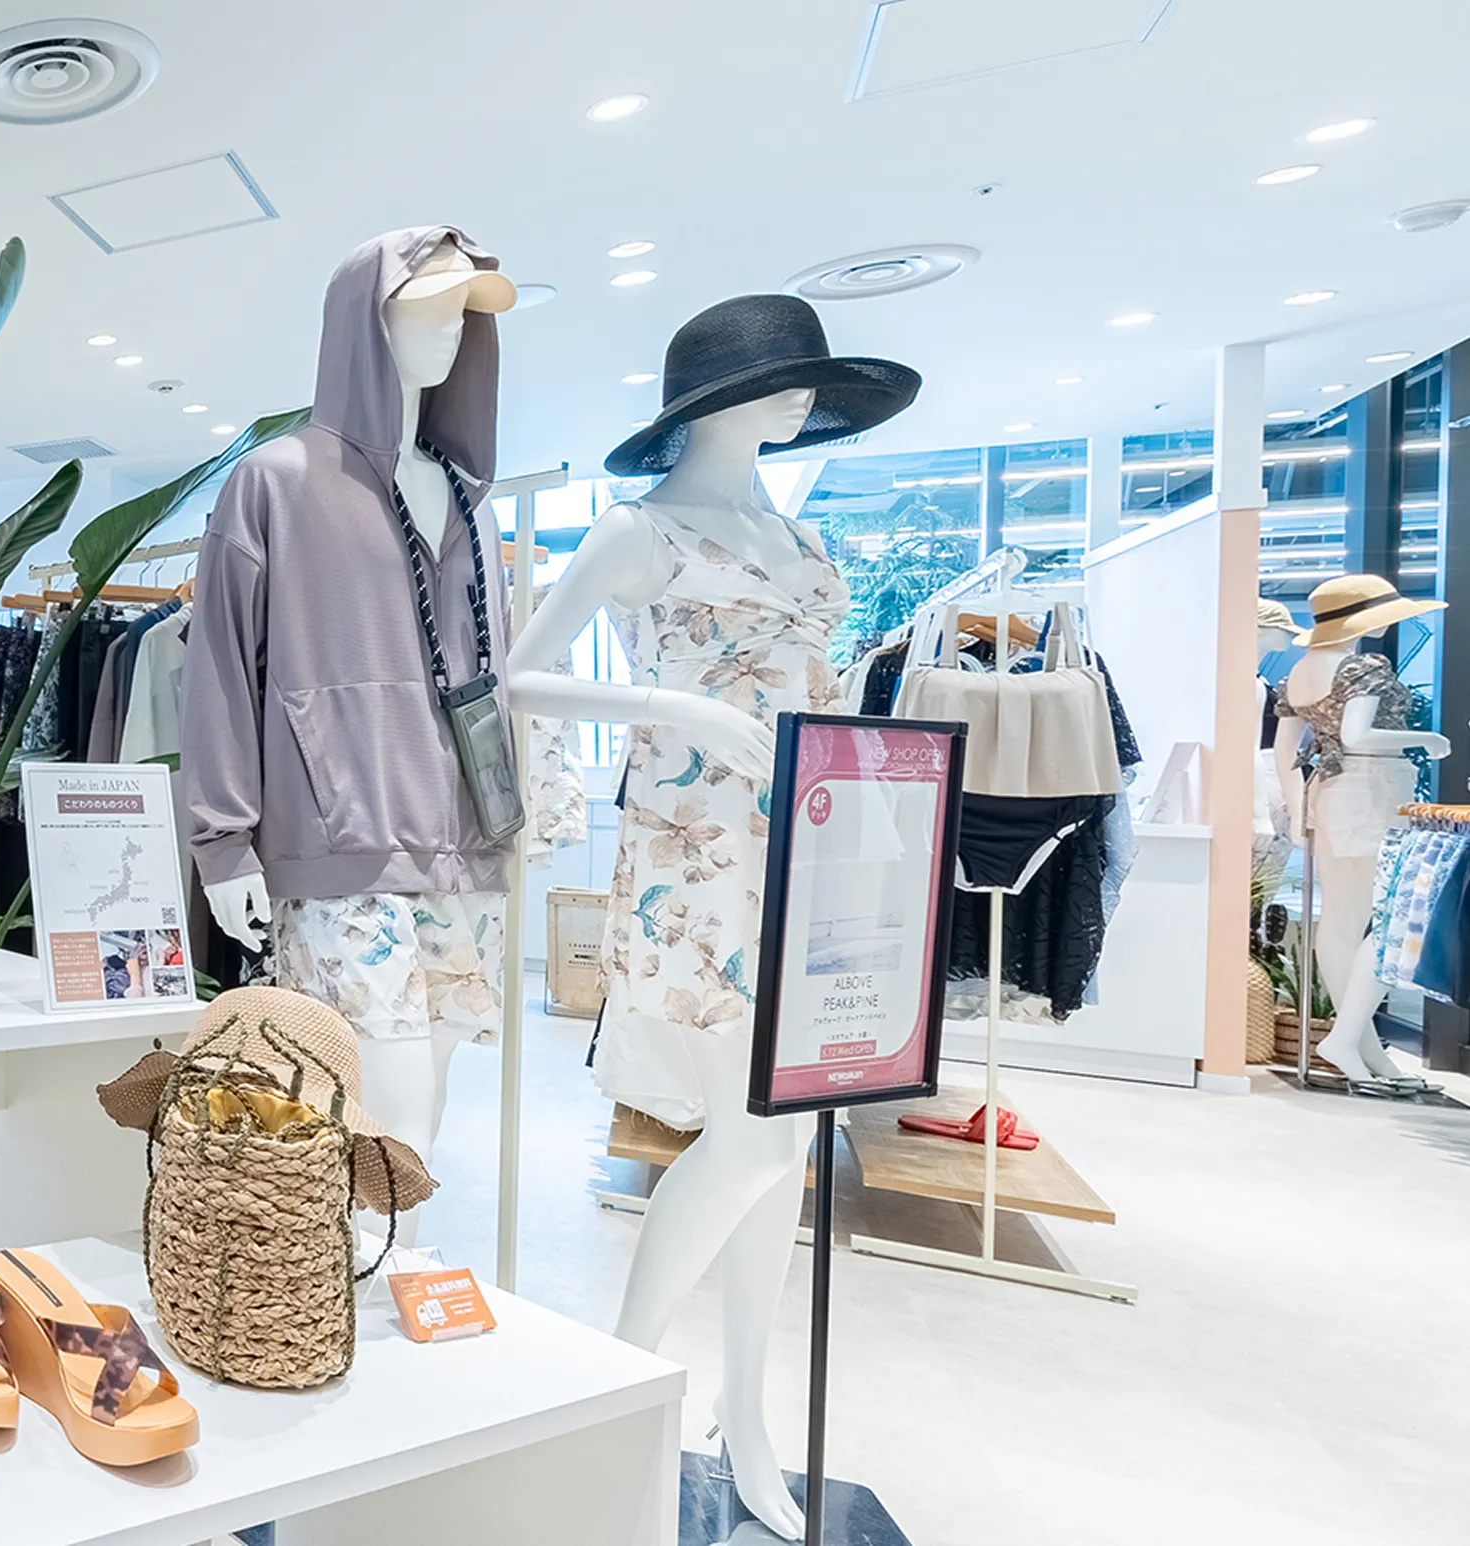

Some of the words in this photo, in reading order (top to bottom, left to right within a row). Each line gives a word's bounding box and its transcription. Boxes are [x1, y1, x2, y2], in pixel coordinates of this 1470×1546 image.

[892, 748, 917, 761] SHOP
[58, 779, 87, 791] Made
[89, 779, 98, 791] in
[101, 780, 140, 792] JAPAN
[63, 799, 139, 810] こだわりのものづくり
[812, 793, 827, 810] 4F
[833, 974, 873, 990] ALBOVE
[823, 994, 879, 1011] PEAK&PINE
